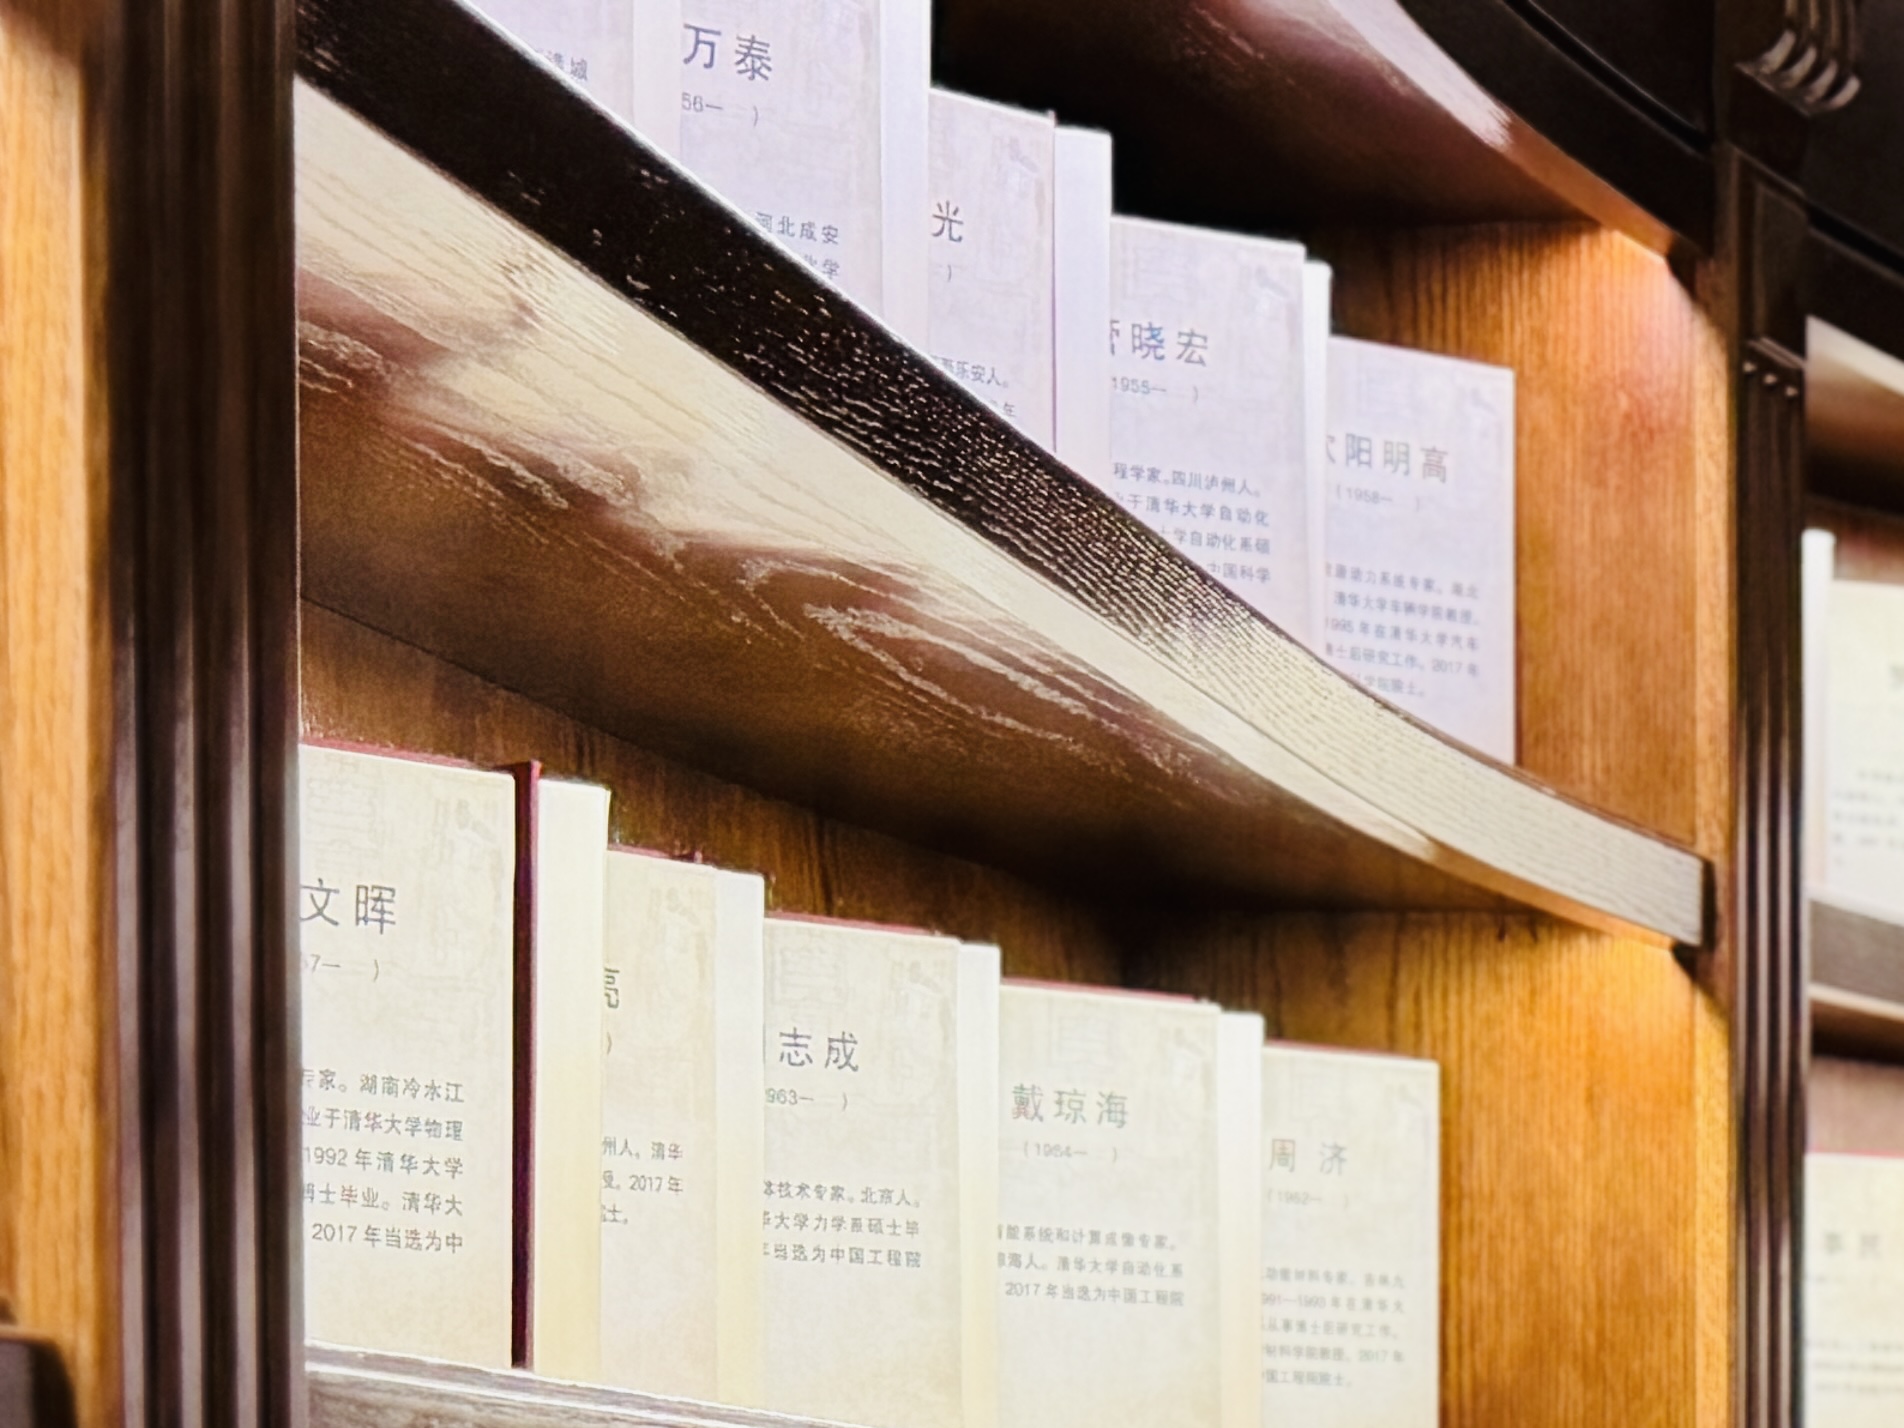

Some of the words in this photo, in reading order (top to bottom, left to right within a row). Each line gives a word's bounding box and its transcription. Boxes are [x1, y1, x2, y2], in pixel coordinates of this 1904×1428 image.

[683, 23, 773, 81] 万泰
[931, 200, 964, 243] 光
[1161, 525, 1271, 556] 学自动化系硕
[1349, 671, 1425, 698] 学院院士。
[300, 878, 396, 935] 文晖
[778, 1026, 859, 1073] 志成
[1011, 1083, 1128, 1129] 戴琼海
[1268, 1137, 1348, 1176] 周济
[311, 1222, 464, 1255] 2017年当选为中
[1262, 1368, 1353, 1388] 国工程院院士。
